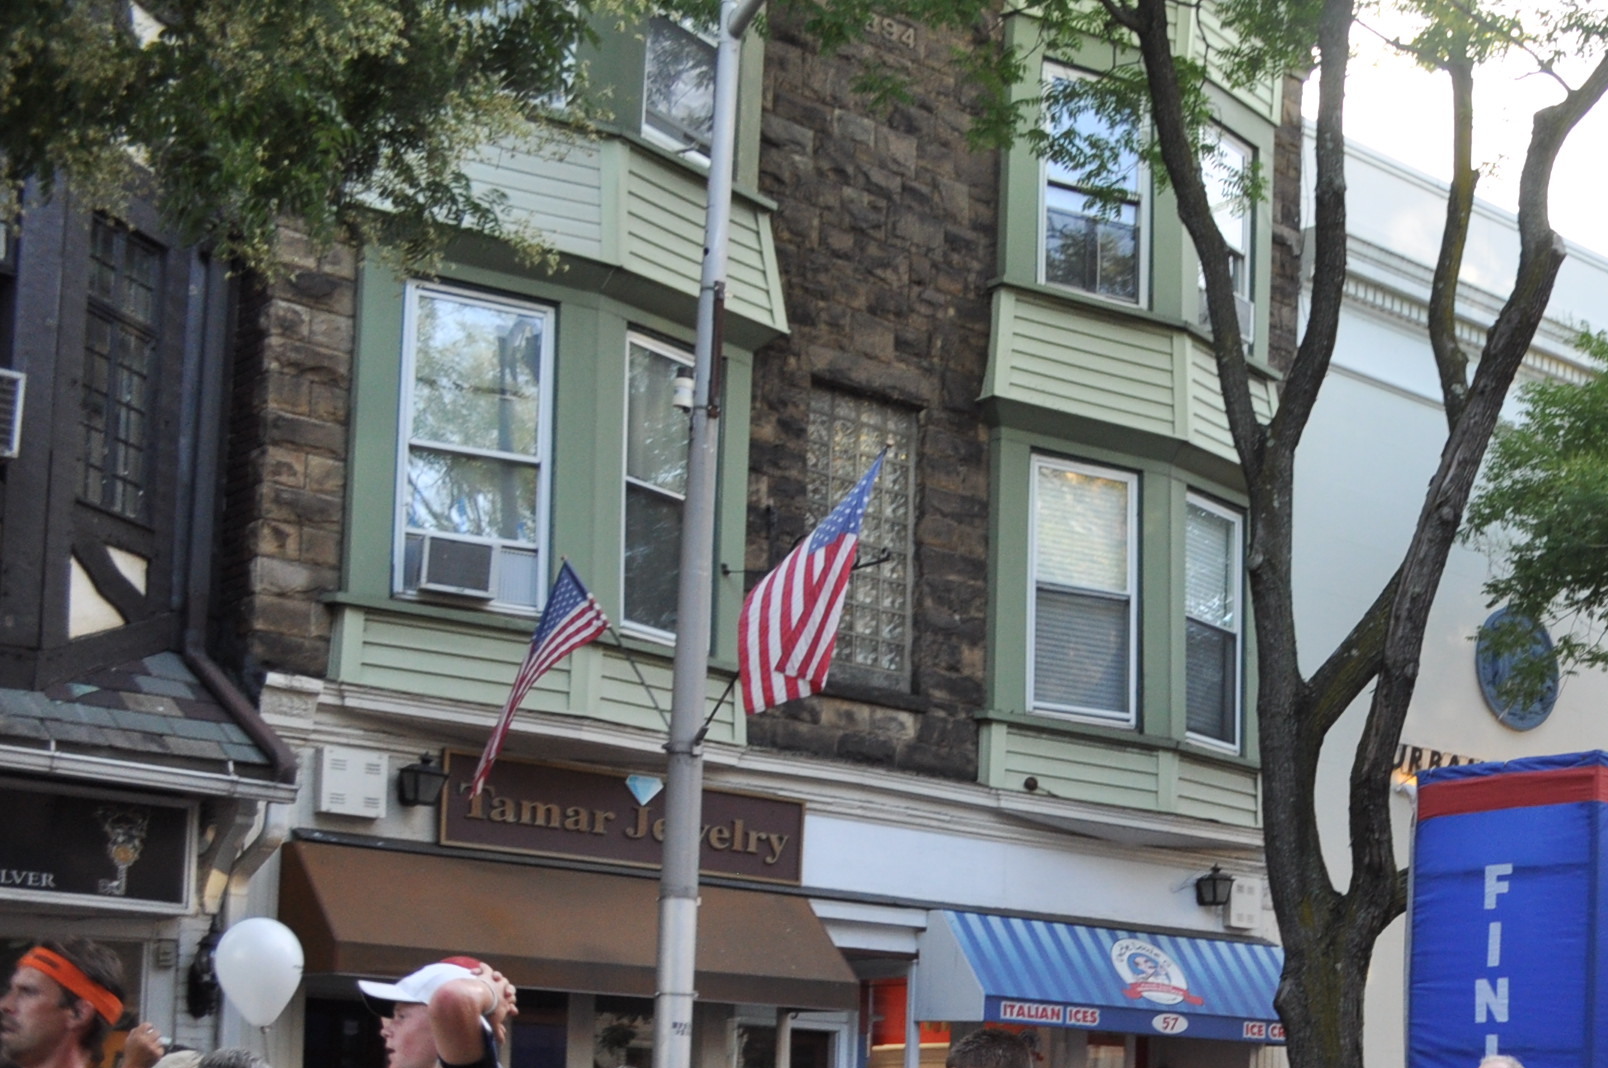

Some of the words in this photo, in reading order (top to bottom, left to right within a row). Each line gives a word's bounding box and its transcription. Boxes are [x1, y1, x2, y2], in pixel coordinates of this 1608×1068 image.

[1394, 744, 1486, 772] URBA
[460, 782, 615, 834] Tamar
[625, 806, 789, 865] Jeelry
[1475, 863, 1513, 1059] FINI
[1002, 1001, 1062, 1021] ITALIAN
[1068, 1006, 1098, 1024] ICES
[1161, 1016, 1180, 1030] 57
[1244, 1023, 1265, 1038] ICE
[1270, 1024, 1286, 1040] CR
